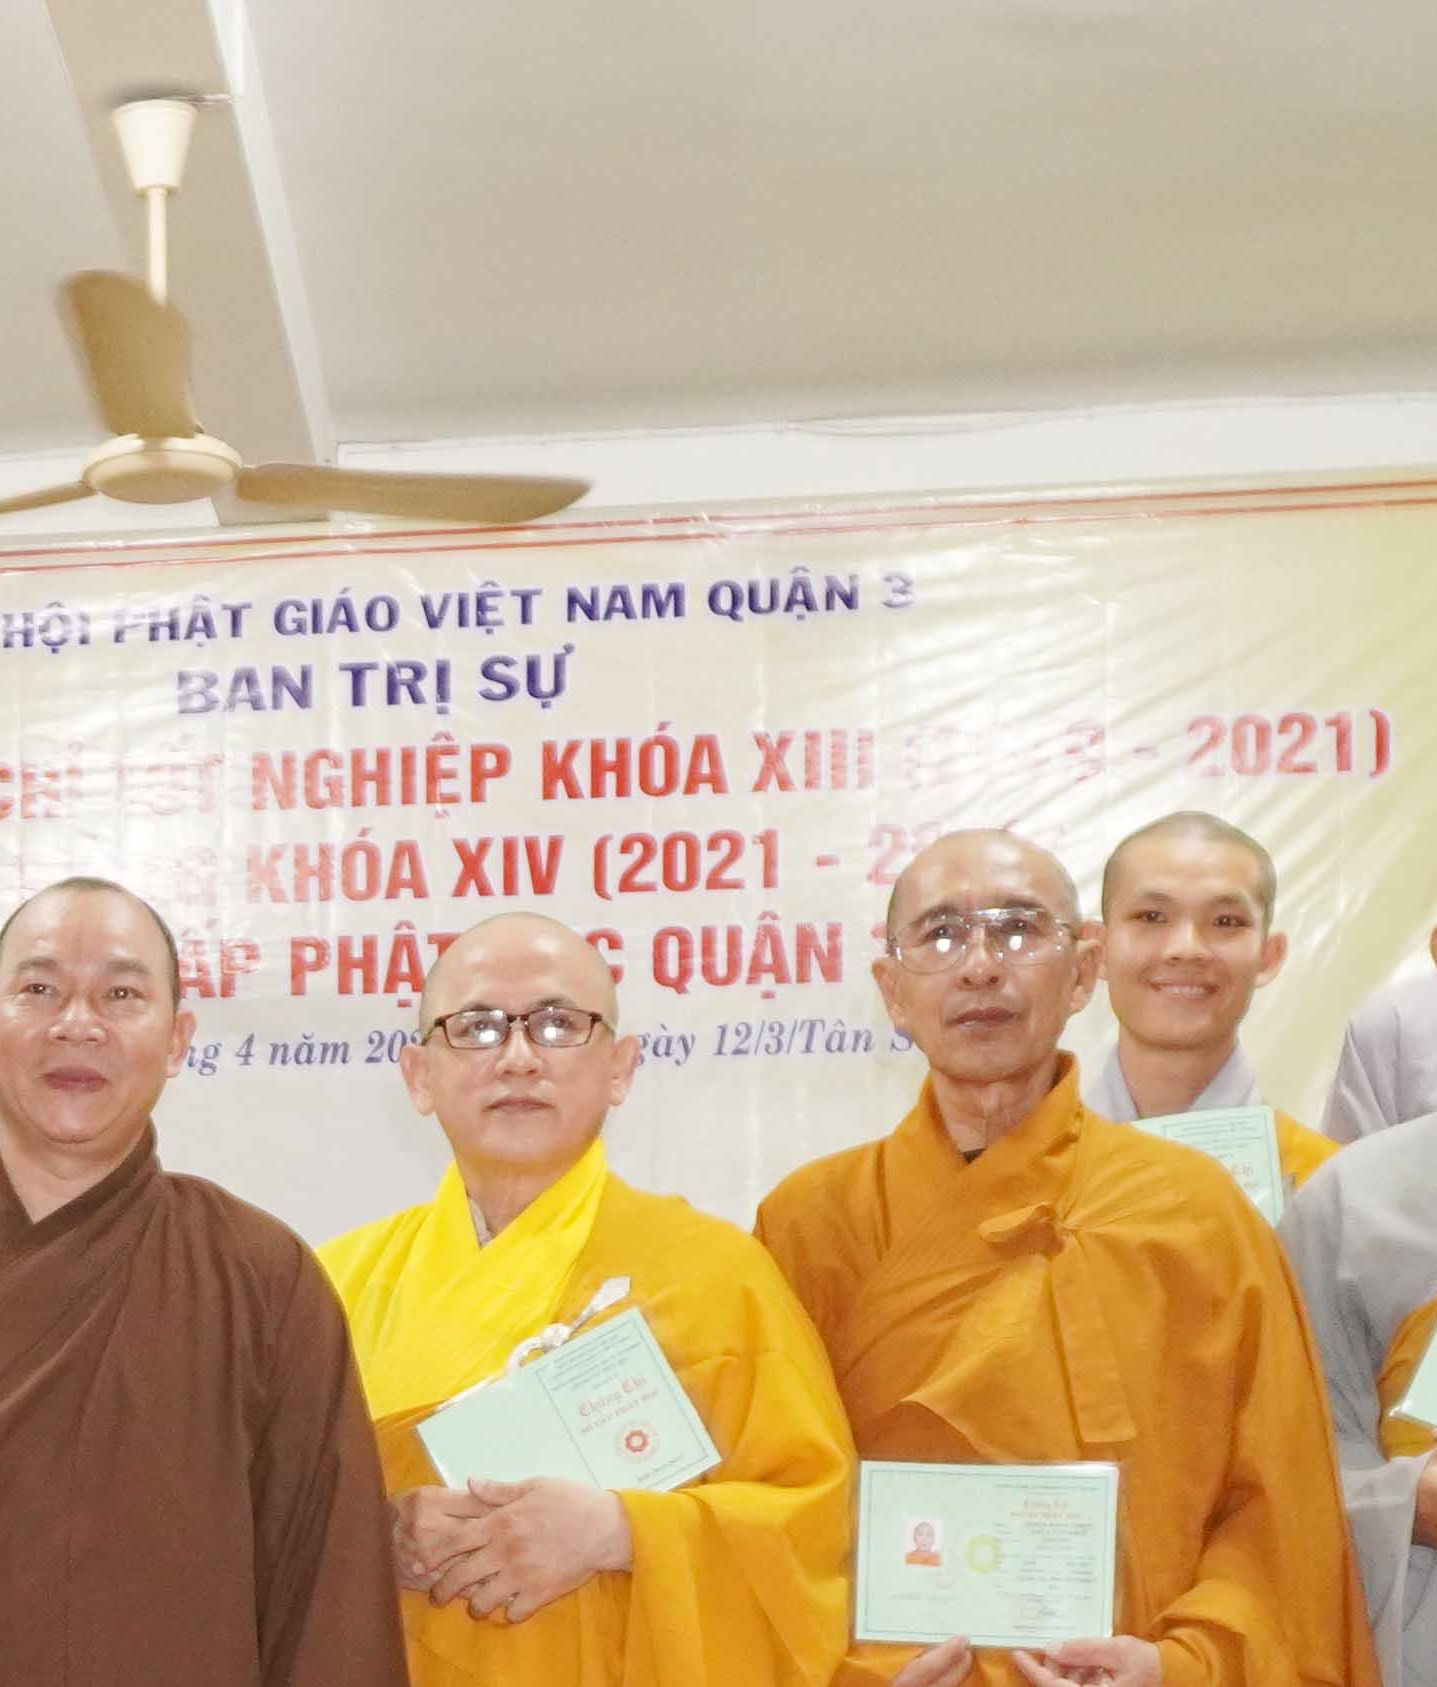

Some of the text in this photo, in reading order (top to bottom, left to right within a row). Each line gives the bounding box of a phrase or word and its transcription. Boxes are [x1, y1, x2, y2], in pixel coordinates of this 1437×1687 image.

[2, 602, 91, 654] HỘI
[113, 593, 252, 648] PHẬT
[273, 587, 400, 636] GIÁO
[423, 581, 542, 635] VIỆT
[567, 581, 686, 623] NAM
[707, 566, 860, 621] QUẬN
[882, 571, 915, 609] 3
[177, 642, 575, 715] BAN TRỊ SỰ
[250, 730, 513, 818] NGHIỆP
[541, 721, 729, 800] KHÓA
[752, 730, 875, 793] XIII
[1187, 708, 1392, 779] 2021)
[245, 826, 430, 903] KHÓA
[451, 834, 565, 897] XIV
[592, 828, 779, 901] (2021
[178, 917, 262, 998] ẤP
[651, 910, 844, 999] QUẬN
[235, 1033, 257, 1067] 4
[268, 1033, 350, 1066] năm
[637, 1023, 696, 1066] gày
[710, 1018, 874, 1058] 12/3/Tân
